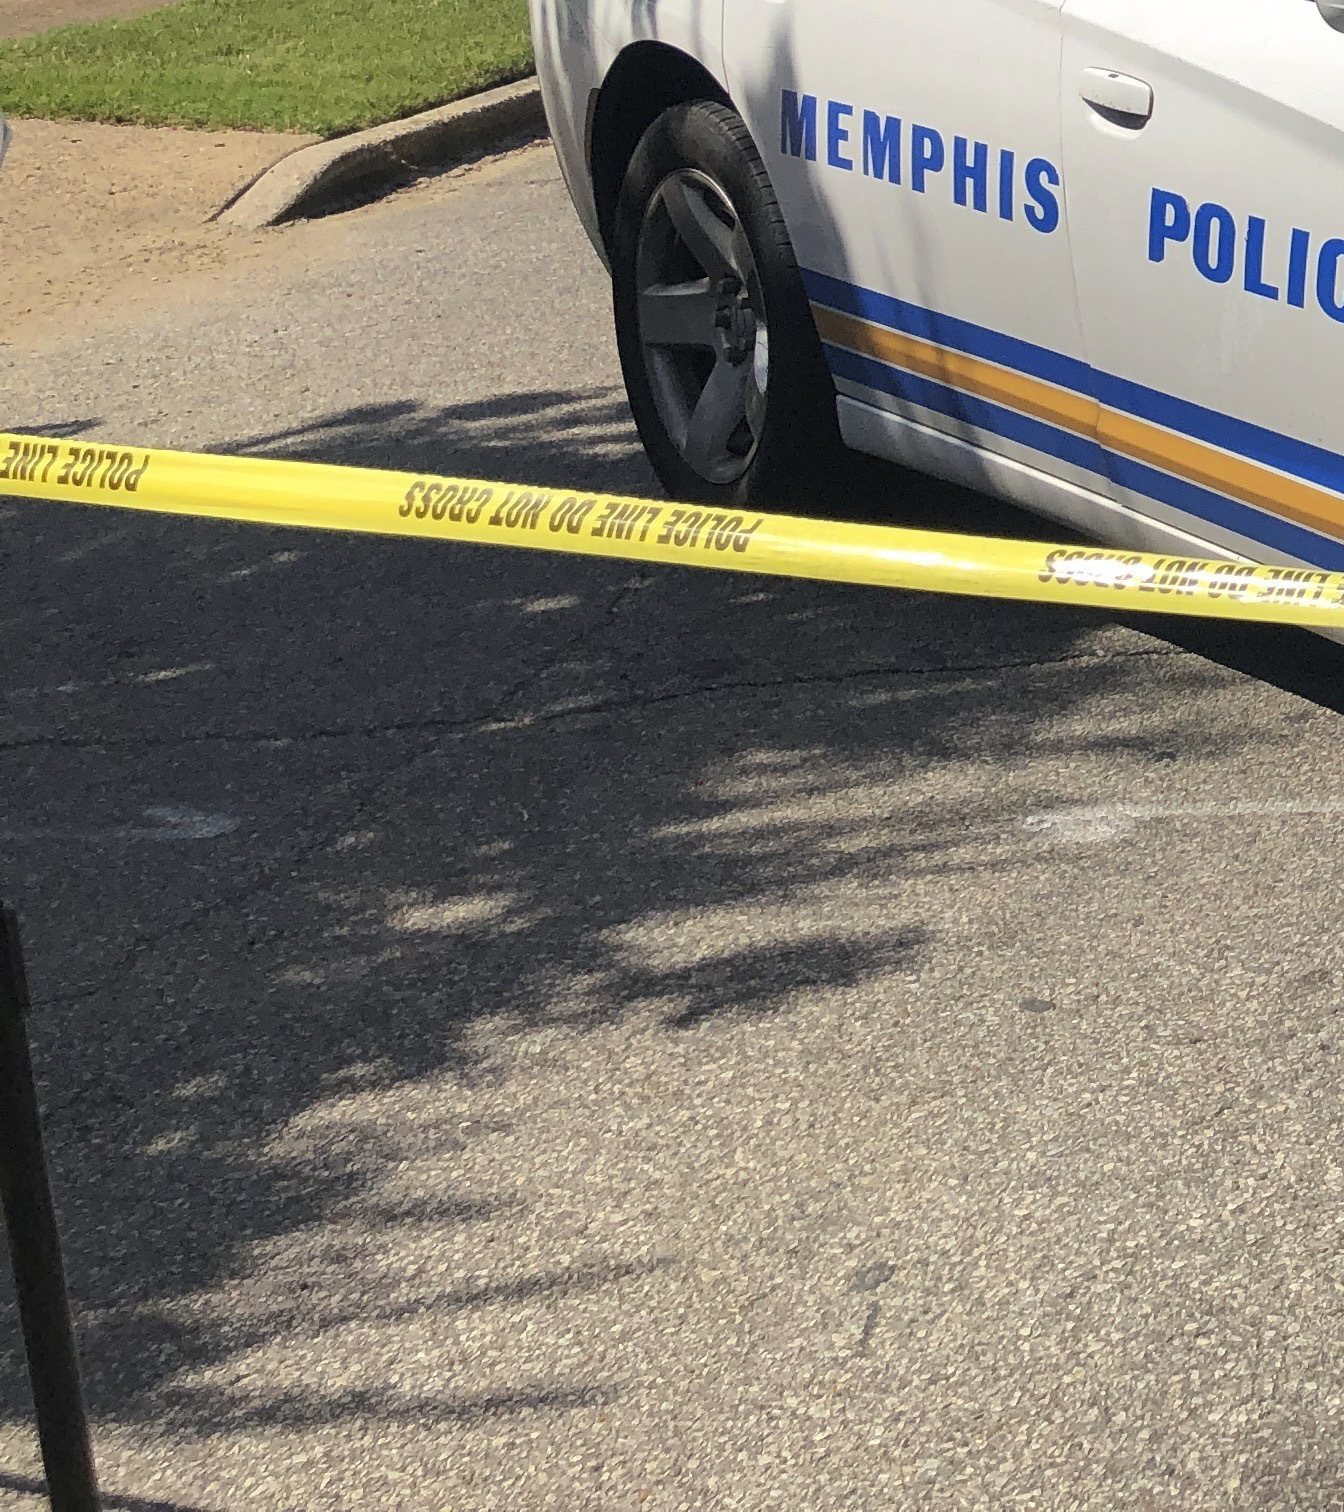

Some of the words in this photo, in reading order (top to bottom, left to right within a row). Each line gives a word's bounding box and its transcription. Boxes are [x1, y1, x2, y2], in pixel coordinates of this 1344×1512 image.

[780, 88, 1063, 234] MEMPHIS
[0, 440, 60, 483] LINE
[57, 447, 150, 492] POLICE
[399, 480, 493, 524] CROSS
[487, 490, 552, 530] NOT
[548, 496, 598, 534] DO
[591, 501, 664, 542] LINE
[656, 507, 765, 553] POLICE
